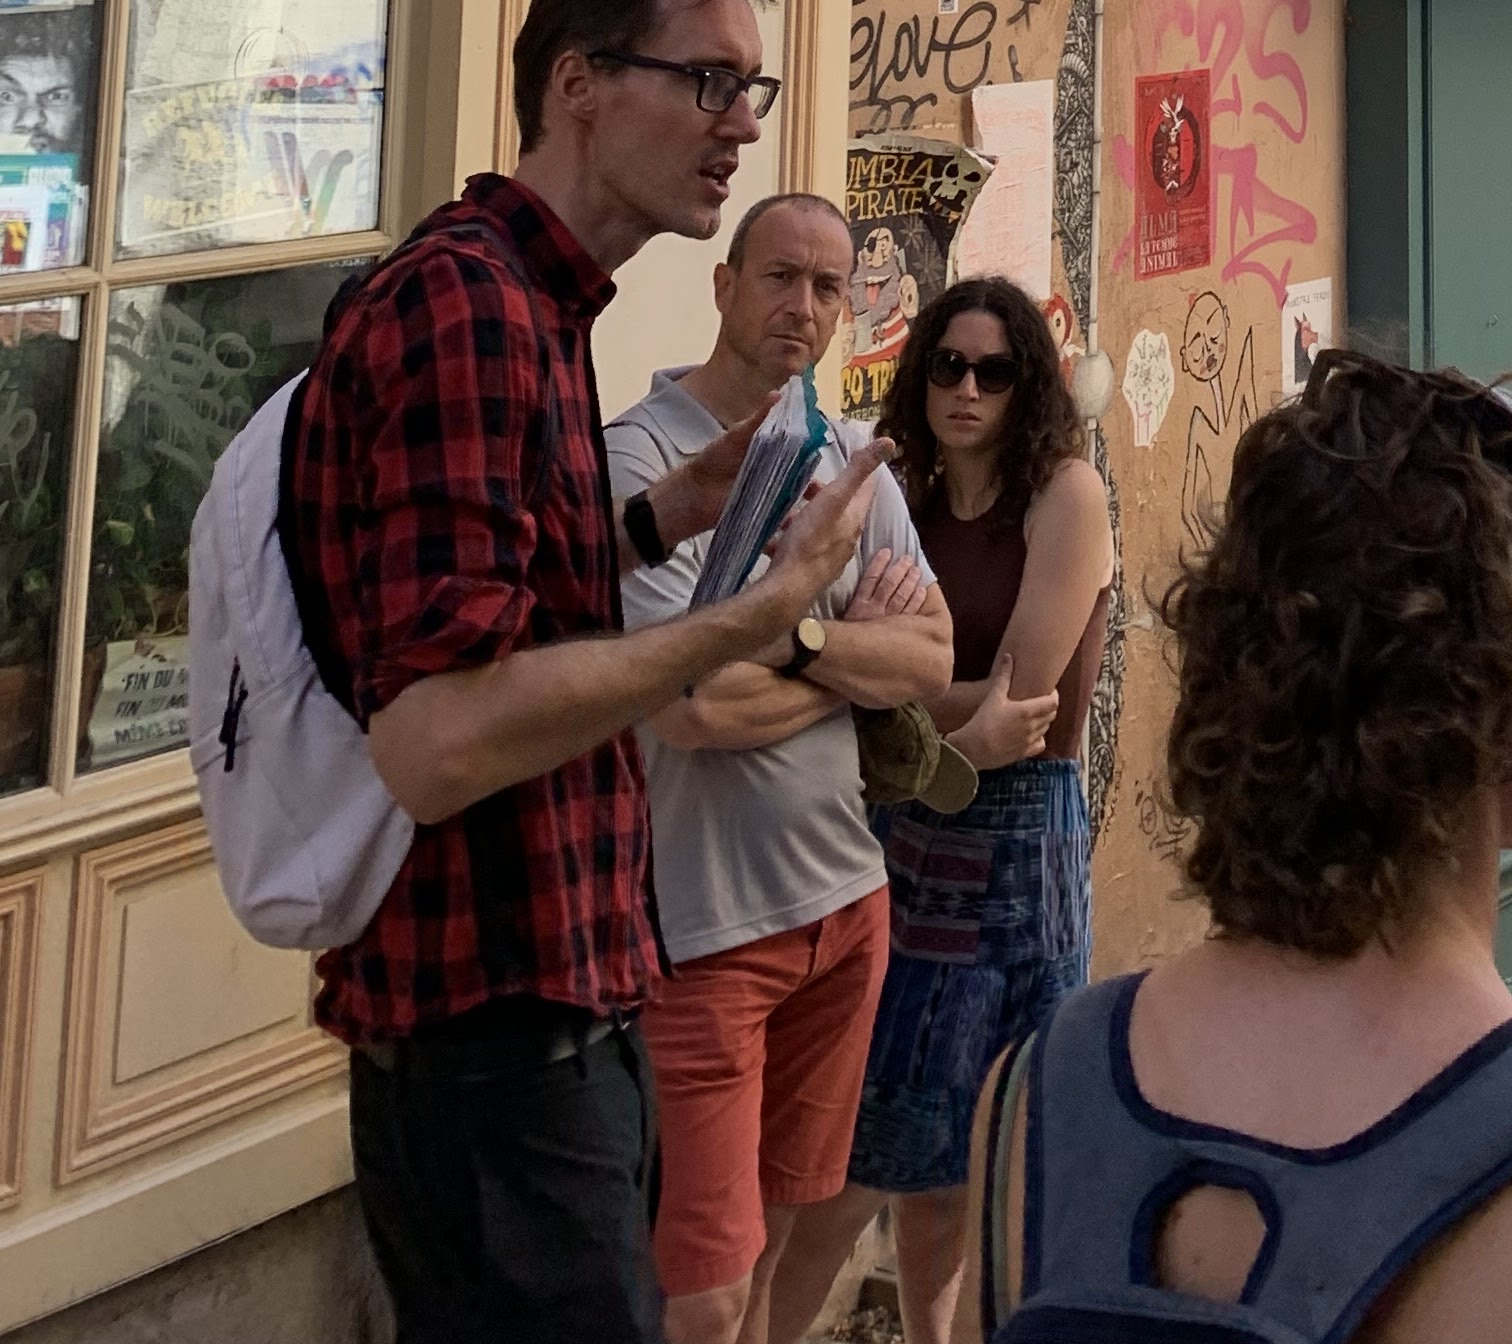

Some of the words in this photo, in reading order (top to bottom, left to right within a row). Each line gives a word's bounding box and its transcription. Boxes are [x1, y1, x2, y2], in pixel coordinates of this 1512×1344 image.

[846, 186, 924, 223] PIRATE
[124, 672, 151, 692] FIN
[115, 699, 143, 718] FIN
